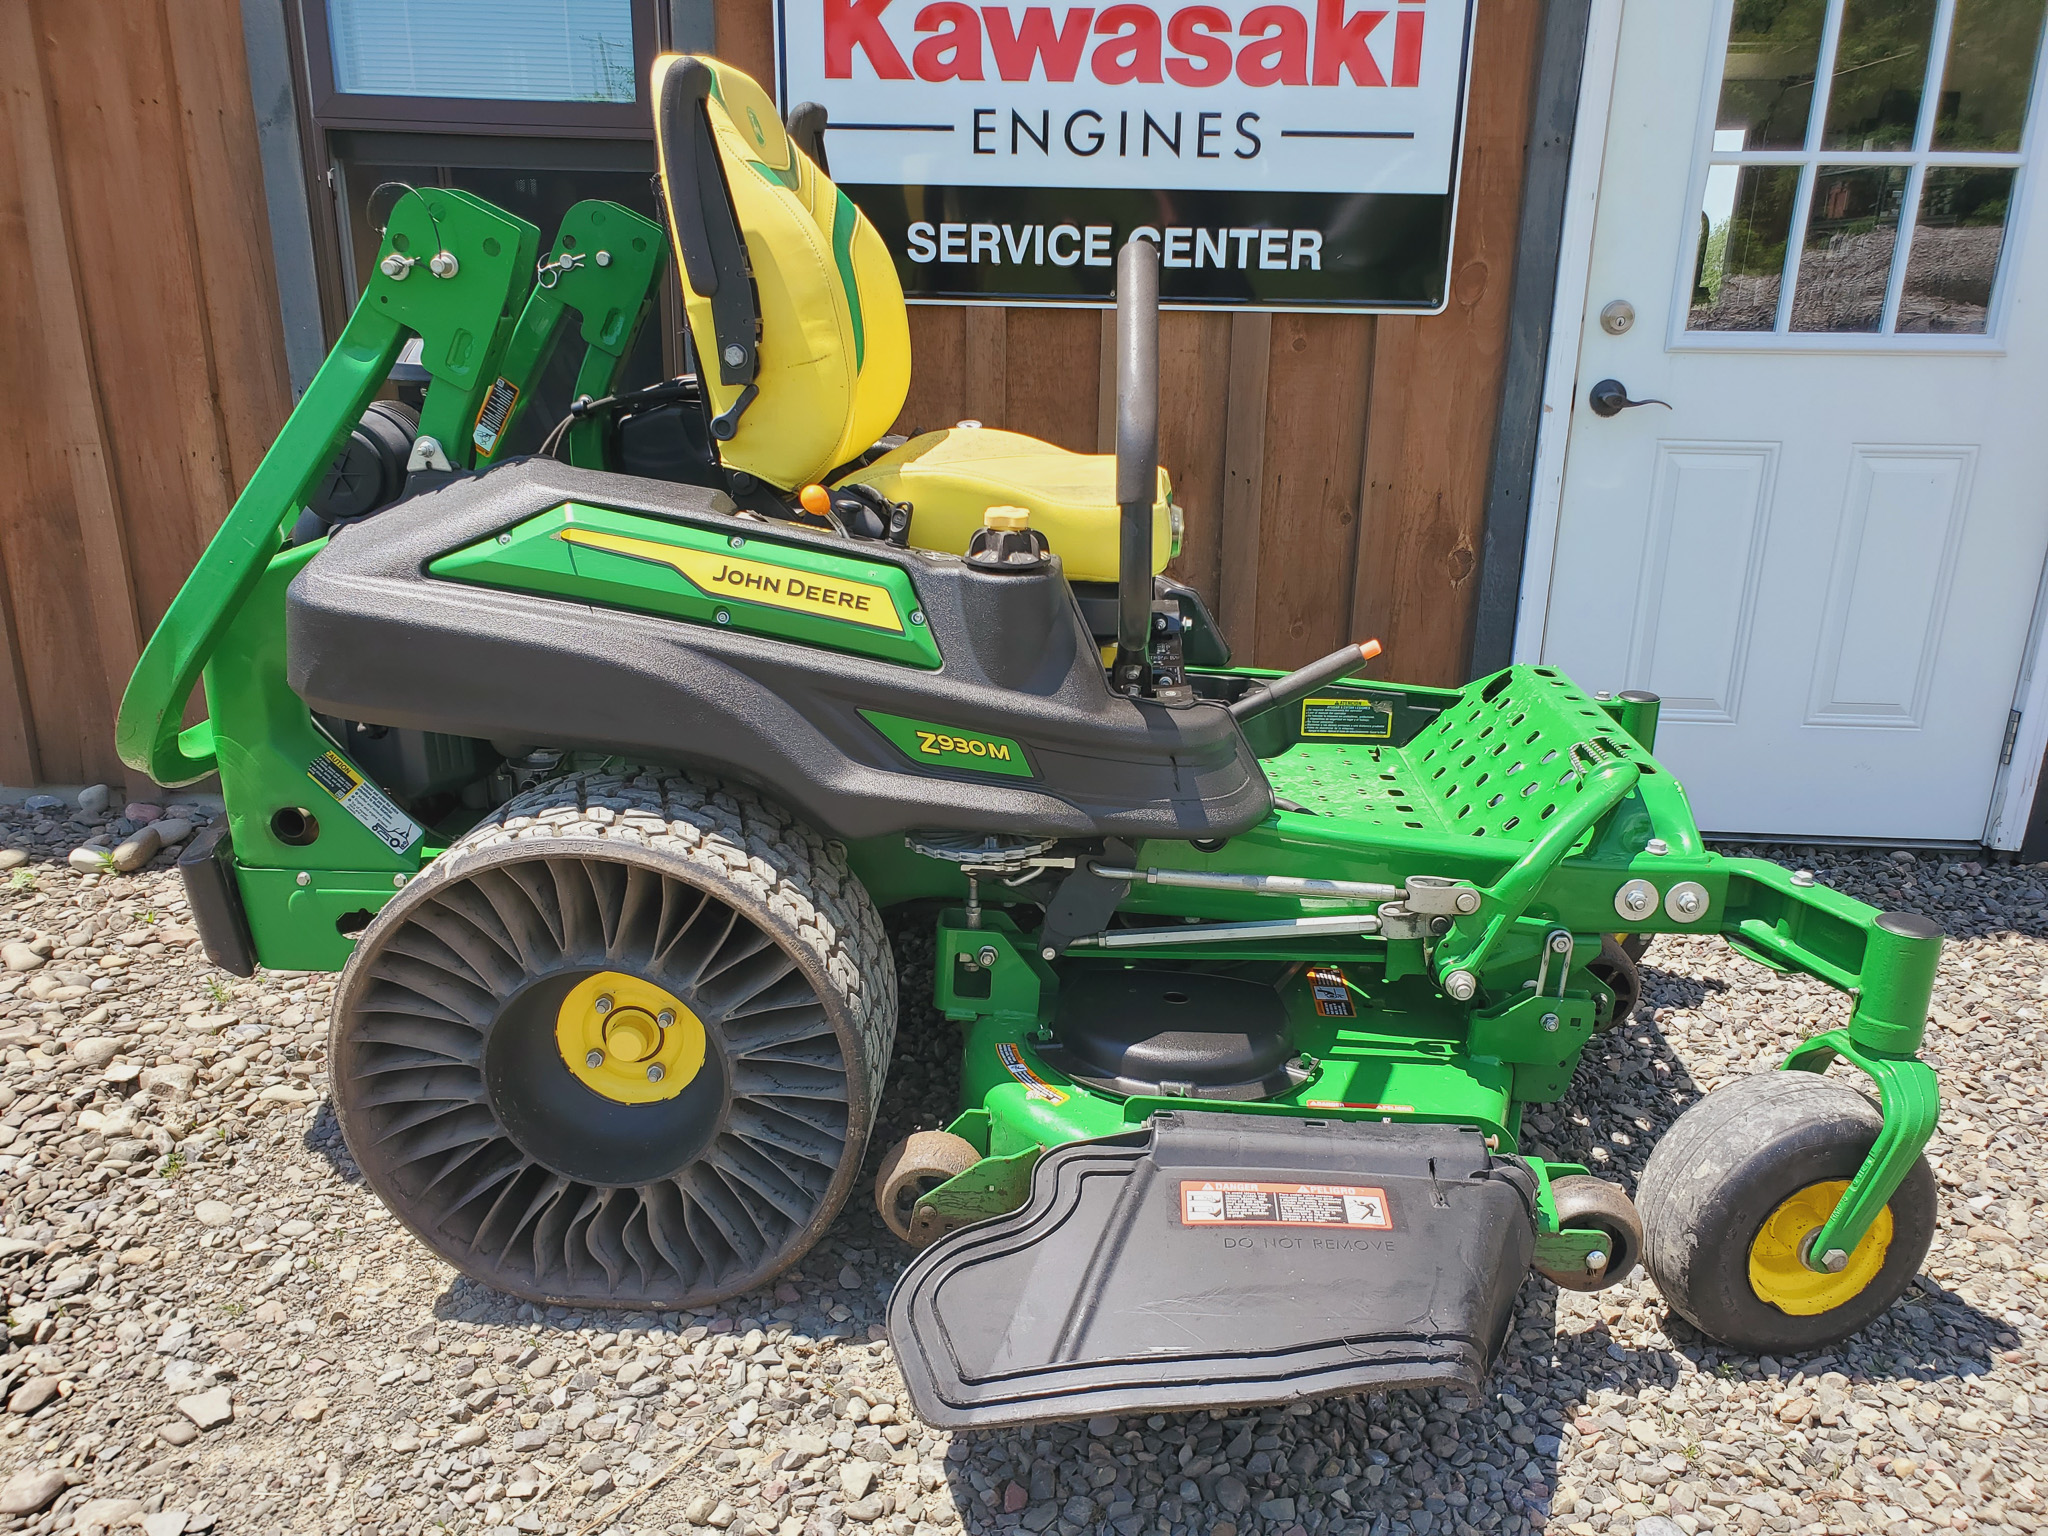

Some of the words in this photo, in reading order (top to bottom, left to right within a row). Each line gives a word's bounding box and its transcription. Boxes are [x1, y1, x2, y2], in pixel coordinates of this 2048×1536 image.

[823, 0, 1424, 88] Kawasaki
[972, 108, 1263, 160] ENGINES
[906, 222, 1112, 268] SERVICE
[712, 565, 782, 594] JOHN
[786, 578, 872, 612] DEERE
[915, 730, 1011, 761] Z930M
[1215, 1182, 1259, 1191] DANGER
[1309, 1186, 1356, 1195] PELIGRO
[1224, 1237, 1254, 1249] DO
[1263, 1237, 1303, 1249] NOT
[1312, 1239, 1396, 1252] REMOVE
